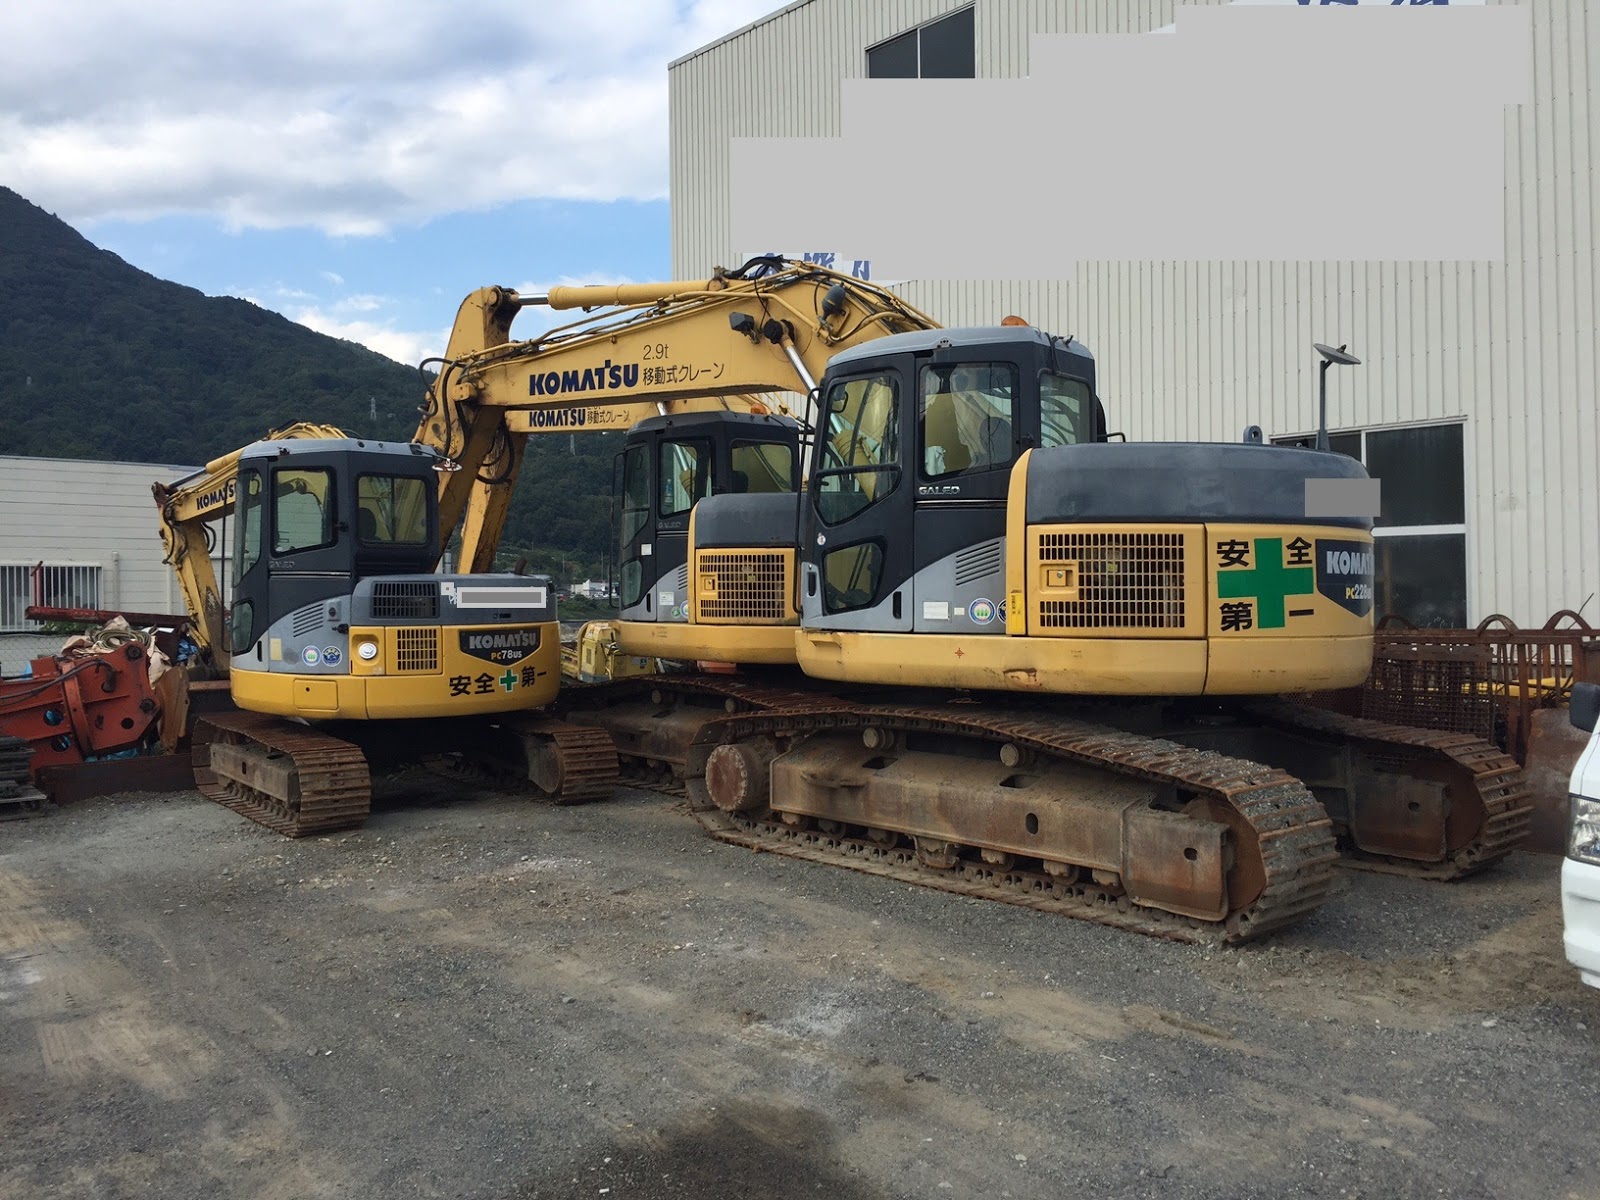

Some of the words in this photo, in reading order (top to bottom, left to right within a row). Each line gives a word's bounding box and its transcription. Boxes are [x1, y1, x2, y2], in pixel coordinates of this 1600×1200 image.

[643, 343, 669, 360] 2.9t
[529, 359, 639, 396] KOMATSU
[642, 362, 725, 387] 移動式クレーン
[529, 407, 586, 427] KOMATSU
[918, 486, 961, 495] GALEO
[469, 630, 537, 649] KOMATSU
[491, 649, 523, 660] PC78US
